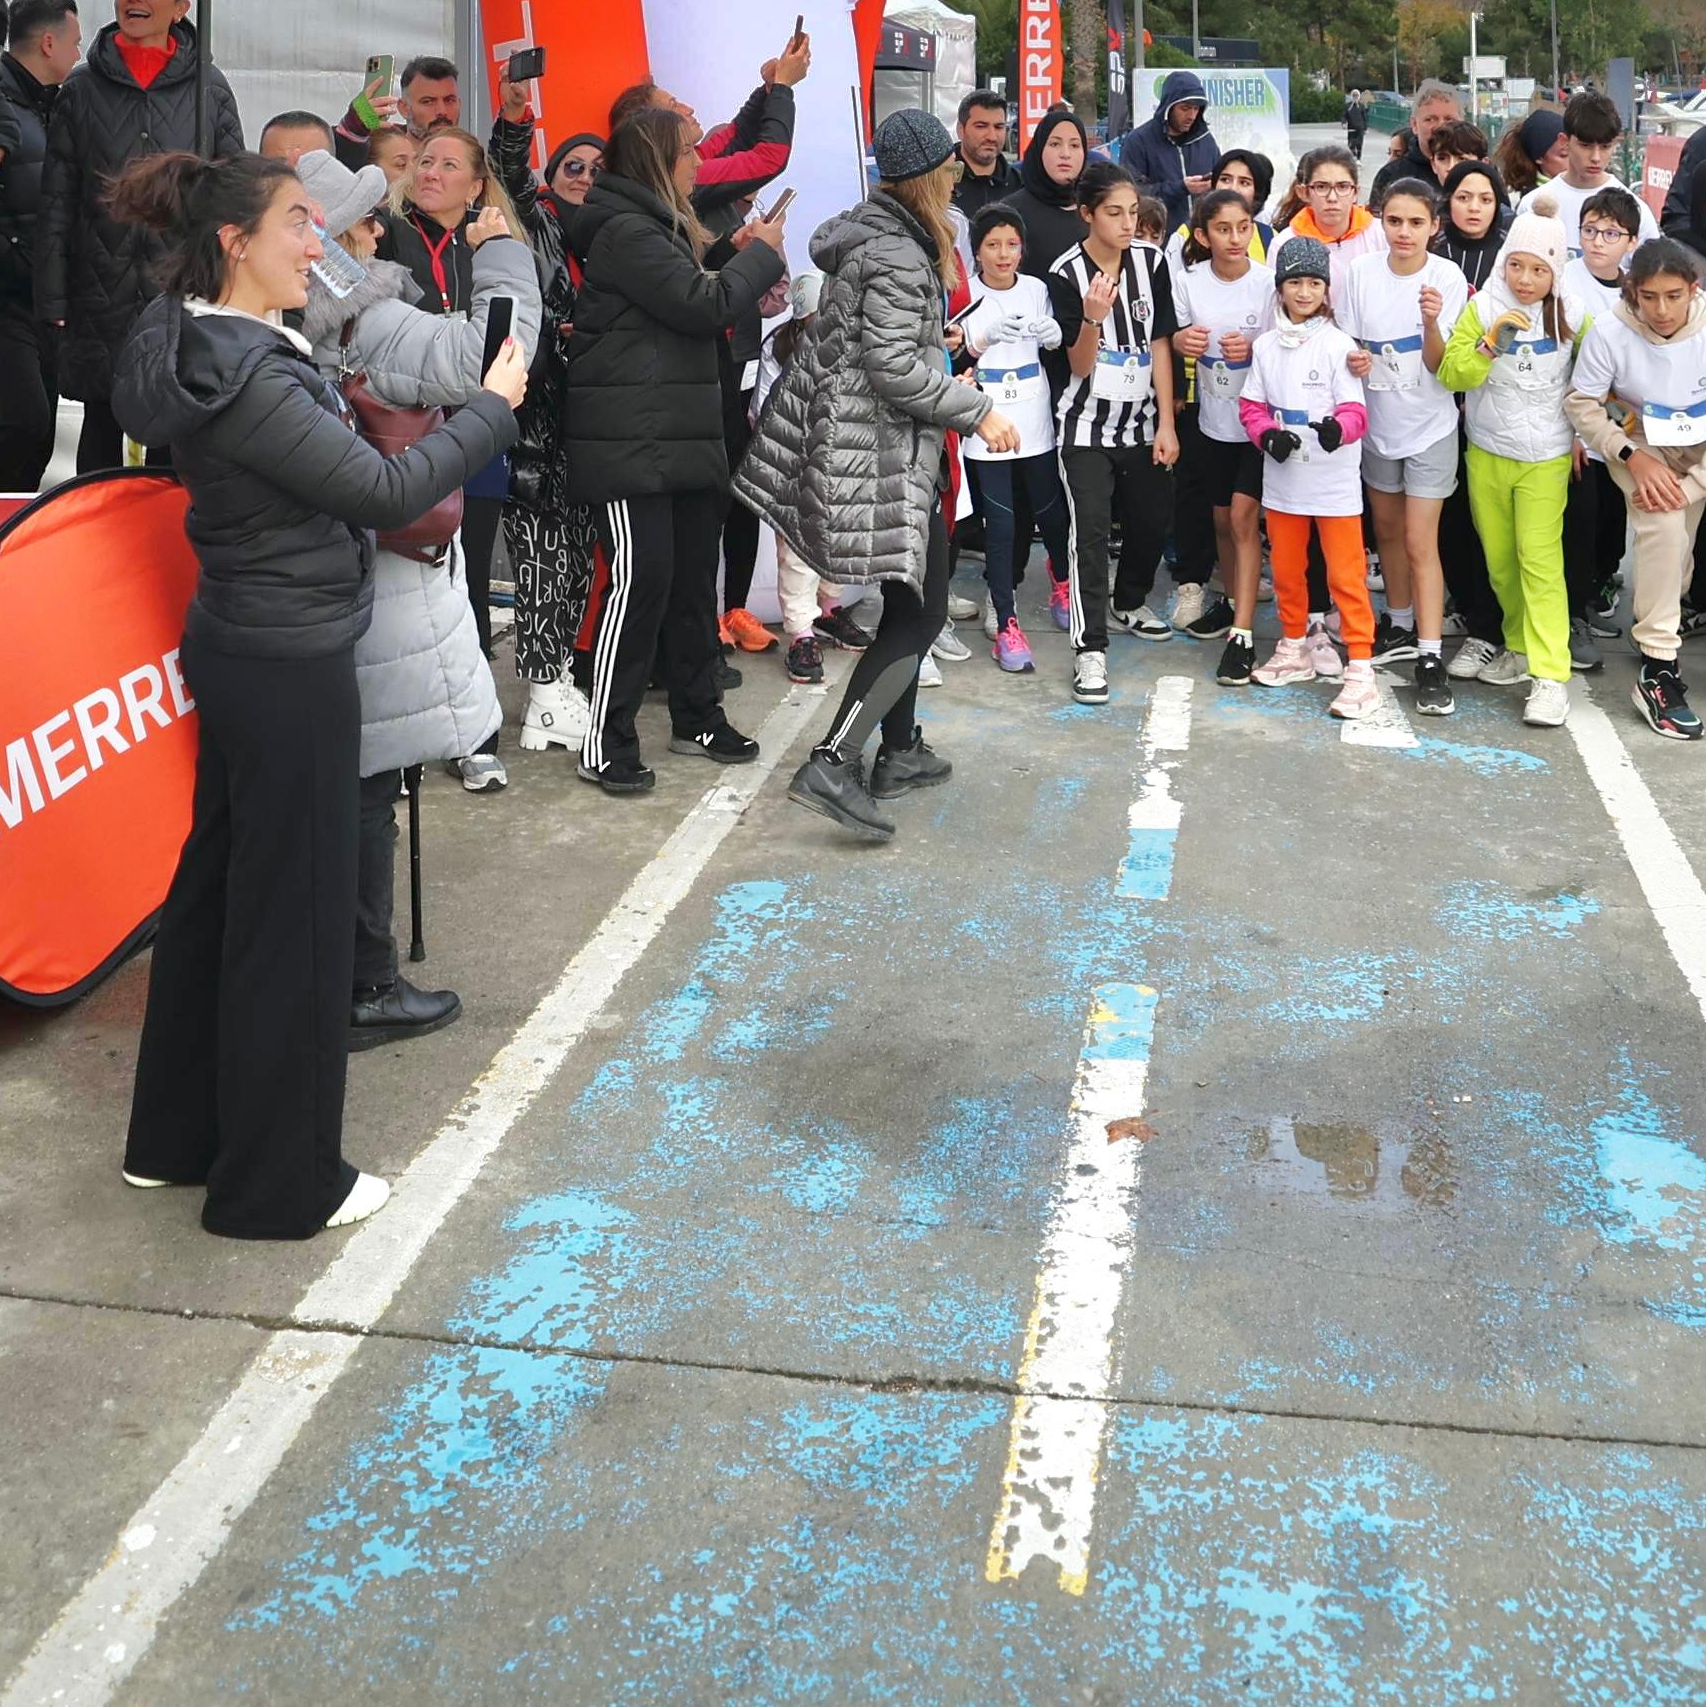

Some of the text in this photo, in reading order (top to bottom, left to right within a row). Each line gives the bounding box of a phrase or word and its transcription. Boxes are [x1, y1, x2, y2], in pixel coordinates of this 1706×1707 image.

[1202, 78, 1265, 107] NISHER
[1518, 362, 1532, 372] 64
[1122, 373, 1136, 385] 79
[1215, 375, 1230, 386] 62
[1004, 389, 1018, 400] 83
[1676, 423, 1692, 433] 49
